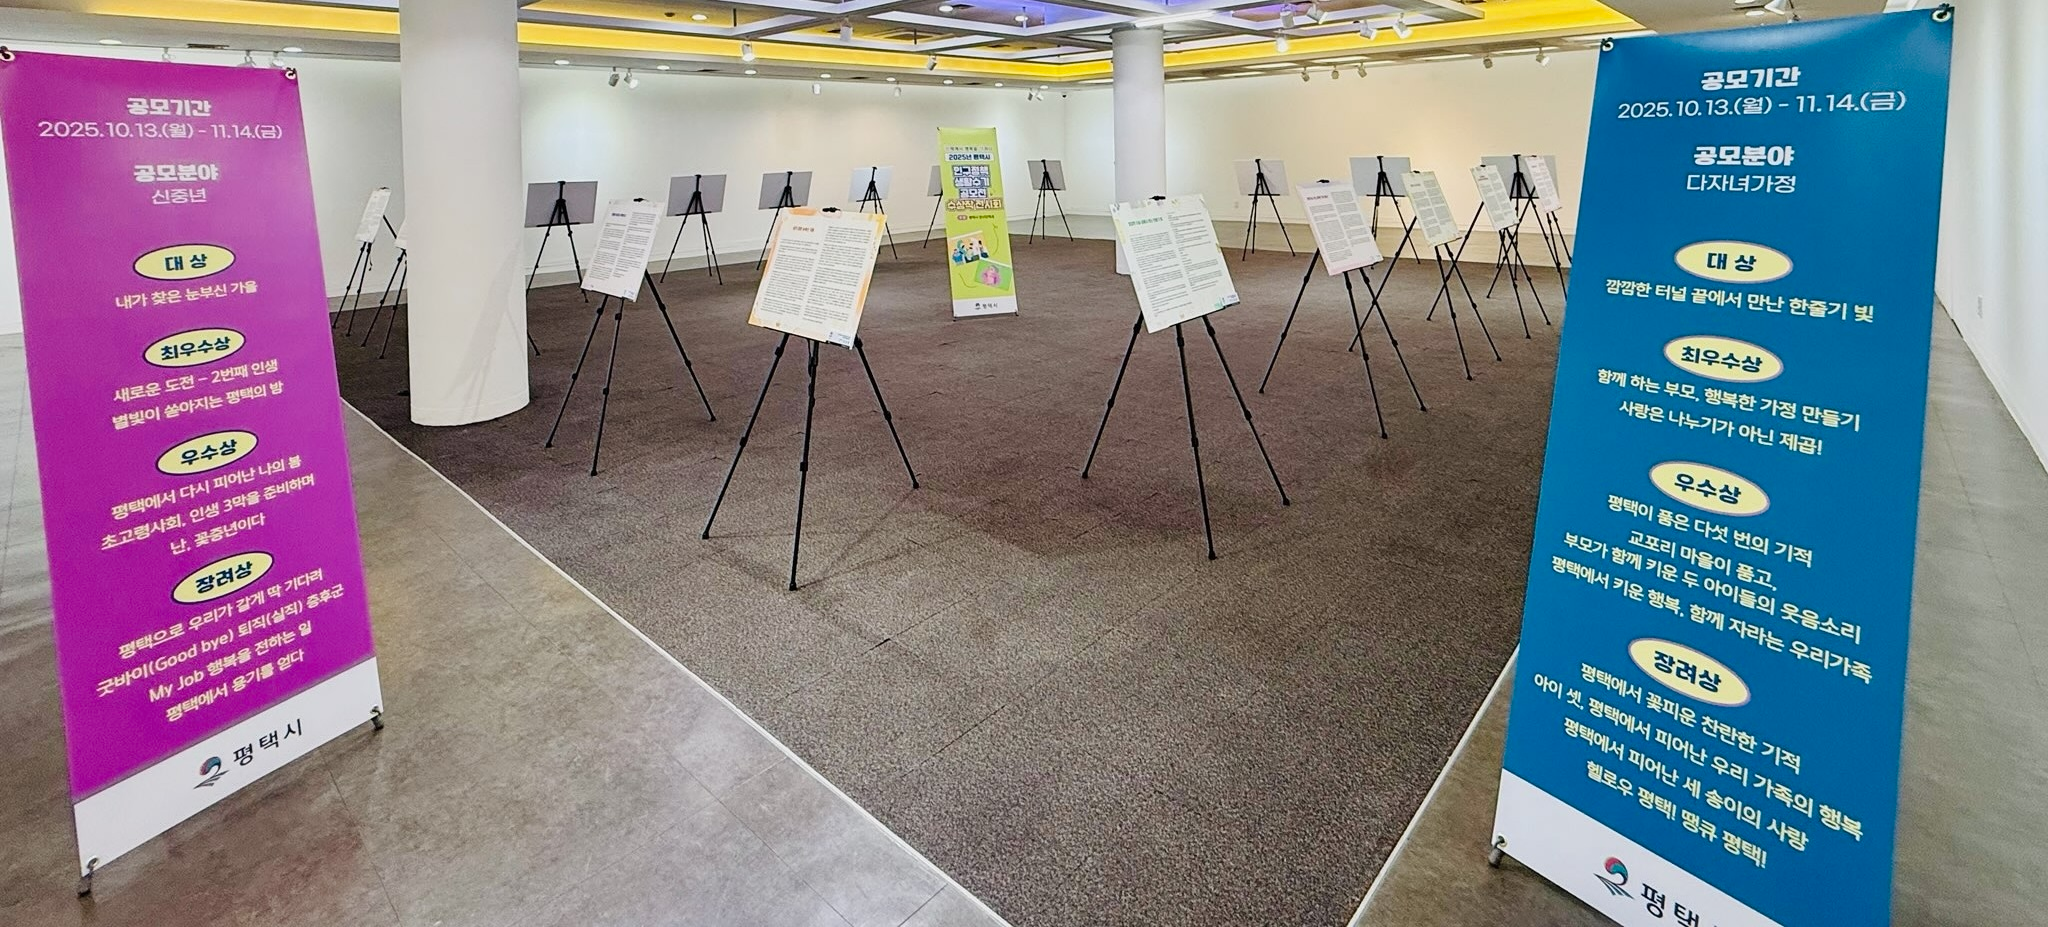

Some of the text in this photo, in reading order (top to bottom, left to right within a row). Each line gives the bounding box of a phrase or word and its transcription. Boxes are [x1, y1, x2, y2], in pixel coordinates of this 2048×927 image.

[1700, 66, 1802, 91] 공모기간
[126, 97, 212, 117] 공모기간
[1617, 96, 1773, 119] 2025.10.13.(월)
[1796, 90, 1907, 113] 11.14.(금)
[38, 120, 194, 139] 2025.10.13.(월)
[210, 123, 283, 139] 11.14.(금)
[133, 163, 219, 183] 공모분야
[1693, 145, 1795, 166] 공모분야
[151, 187, 207, 205] 신중년
[1686, 174, 1797, 194] 다자녀가정
[115, 280, 258, 309] 내가 찾은 눈부신 가을
[1606, 279, 1874, 323] 깜깜한 터널 끝에서 만난 한줄기 빛
[160, 336, 232, 361] 최우수상
[1680, 345, 1764, 374] 최우수상
[113, 382, 161, 403] 새로운
[165, 374, 195, 391] 도전
[211, 364, 249, 384] 2번째
[251, 358, 279, 375] 인생
[1598, 368, 1861, 432] 함께 하는 부모, 행복한 가정 만들기
[112, 380, 284, 431] 별빛이 쏟아지는 평택의 밤
[1618, 400, 1823, 456] 사랑은 나누기가 아닌 제곱!
[180, 438, 238, 467] 우수상
[111, 454, 302, 520] 평택에서 다시 피어난 나의 봄
[1673, 472, 1742, 506] 우수상
[101, 473, 315, 551] 초고령사회, 인생 3막을 준비하며
[170, 512, 266, 556] 난, 꽃중년이다
[1607, 494, 1813, 569] 평택이 품은 다섯 번의 기적
[195, 560, 254, 594] 장려상
[1628, 530, 1777, 592] 교포리 마을이 품고,
[1563, 532, 1861, 645] 부모가 함께 키운 두 아이들의 웃음소리
[118, 567, 323, 660] 평택으로 우리가 갈게 딱 기다려
[1551, 555, 1873, 685] 평택에서 키운 행복, 함께 자라는 우리가족
[95, 583, 345, 698] 굿바이(Good bye) 퇴직(실직) 증후군
[148, 620, 312, 703] My Job 행복을 전하는 일
[165, 648, 305, 722] 평택에서 용기를 얻다
[1652, 649, 1723, 694] 장려상
[232, 717, 303, 767] 평택시
[1581, 662, 1801, 775] 평택에서 꽃피운 찬란한 기적
[1534, 673, 1864, 842] 아이 셋, 평택에서 피어난 우리 가족의 행복
[1563, 717, 1810, 852] 평택에서 피어난 세 송이의 사랑
[1587, 760, 1767, 869] 헬로우 평택! 땡큐 평택!
